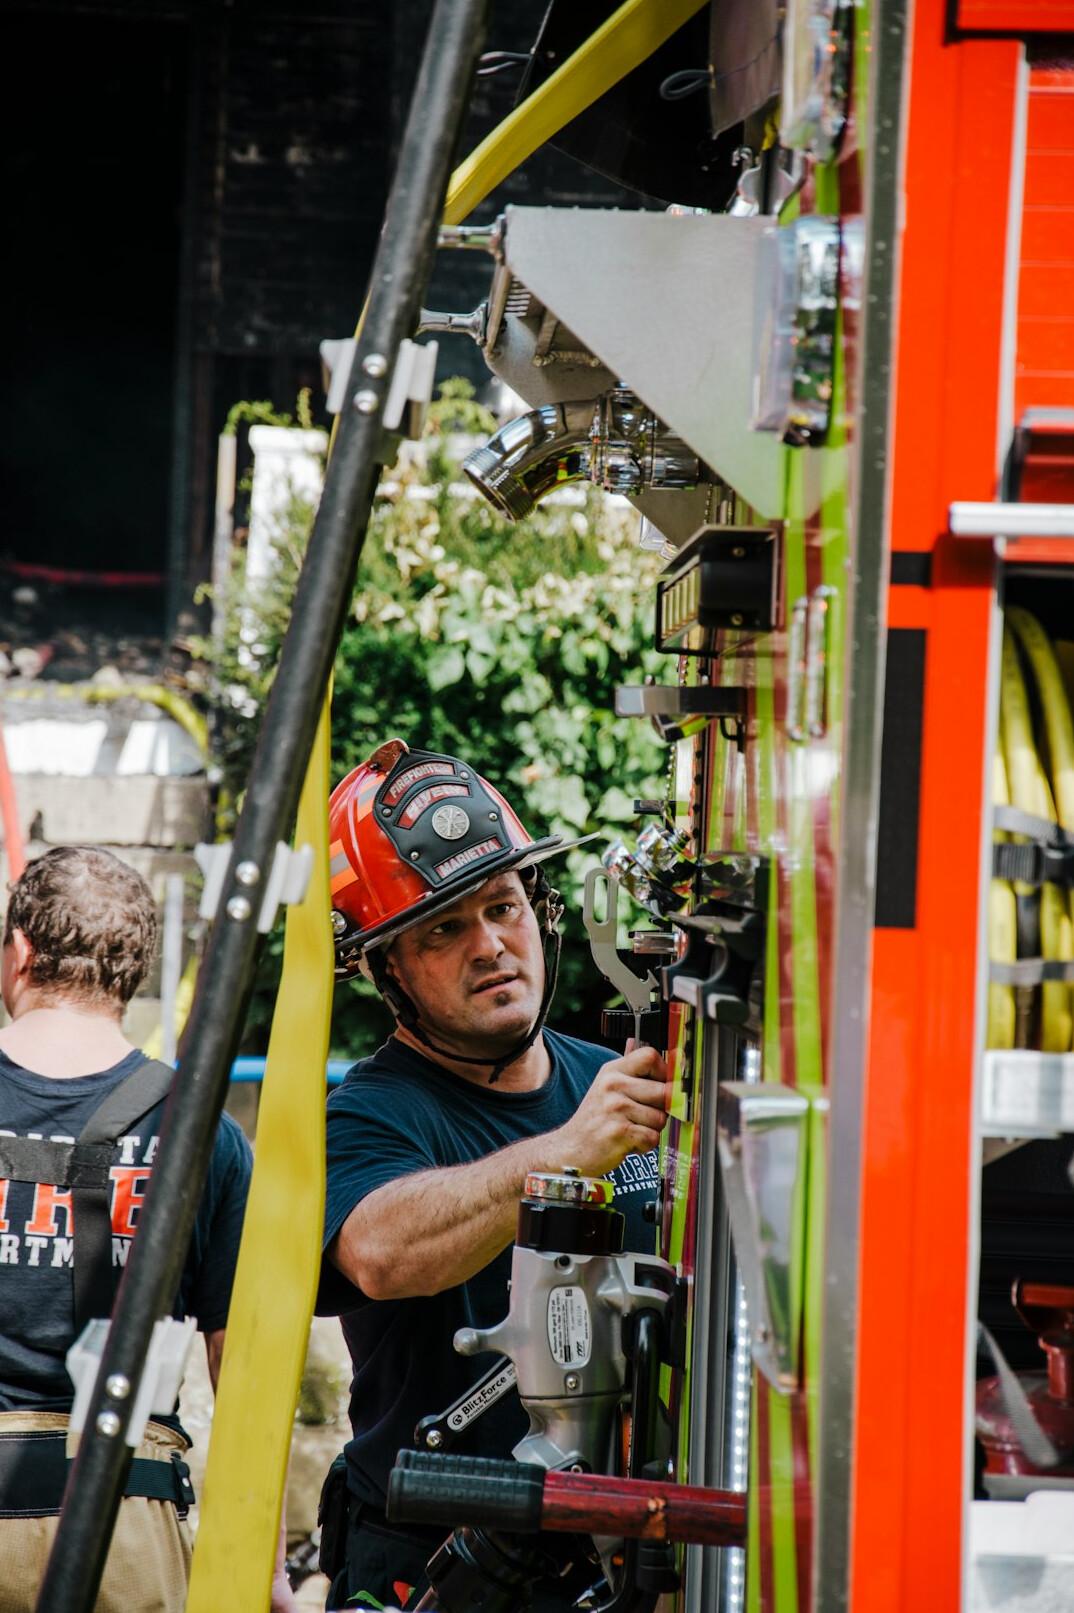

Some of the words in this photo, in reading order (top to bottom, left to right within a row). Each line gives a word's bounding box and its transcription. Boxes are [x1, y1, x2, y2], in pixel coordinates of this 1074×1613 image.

[389, 762, 450, 799] FIREFIGHTER
[440, 839, 500, 879] MARIETTA
[461, 1376, 507, 1415] BlitzForce
